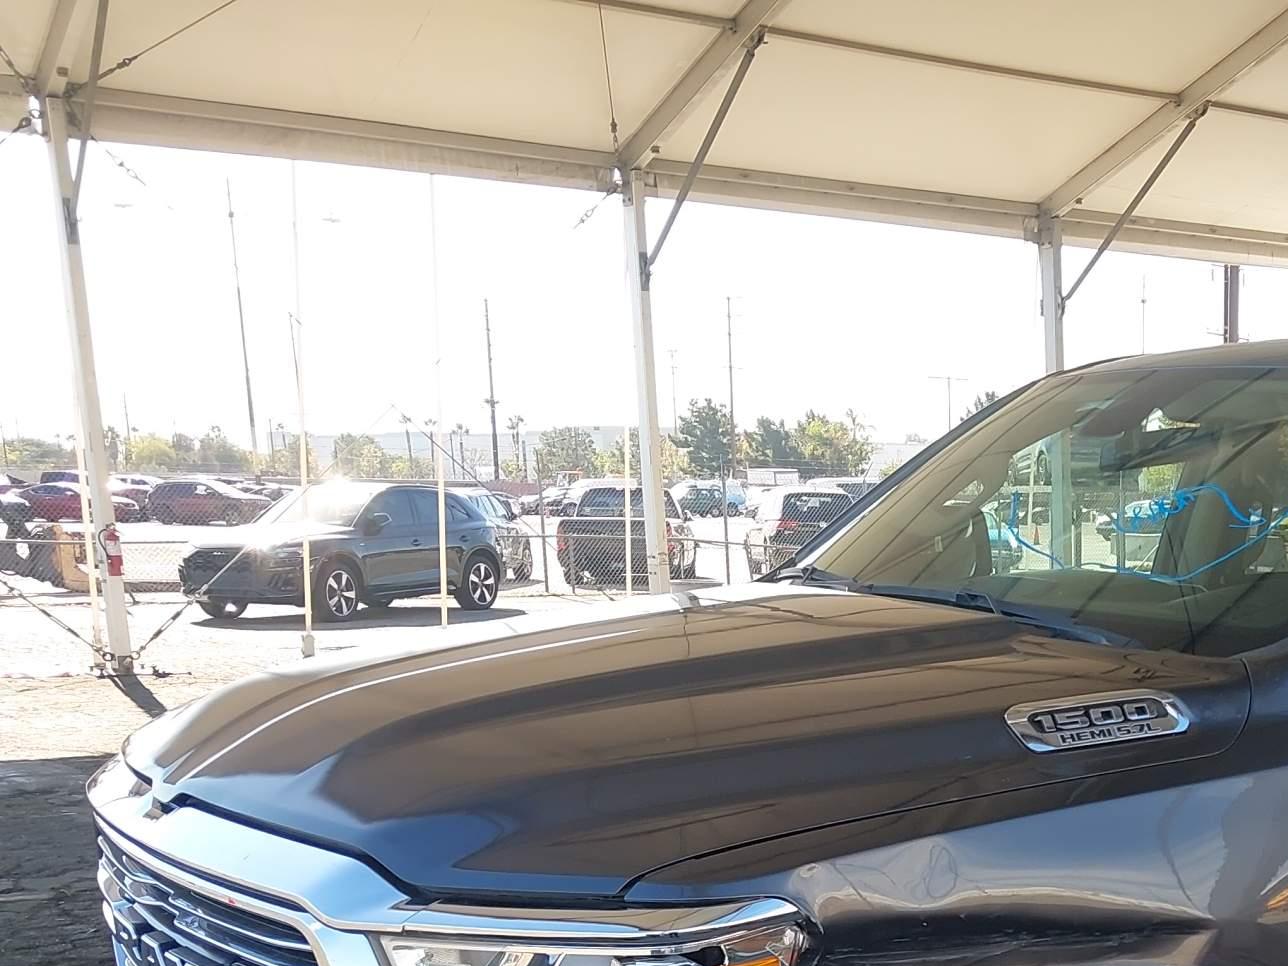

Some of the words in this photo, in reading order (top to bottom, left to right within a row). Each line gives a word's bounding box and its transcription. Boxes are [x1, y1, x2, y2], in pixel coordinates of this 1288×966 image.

[1034, 702, 1158, 733] 1500
[1059, 729, 1113, 746] HEMI
[1118, 723, 1161, 738] 5.7L
